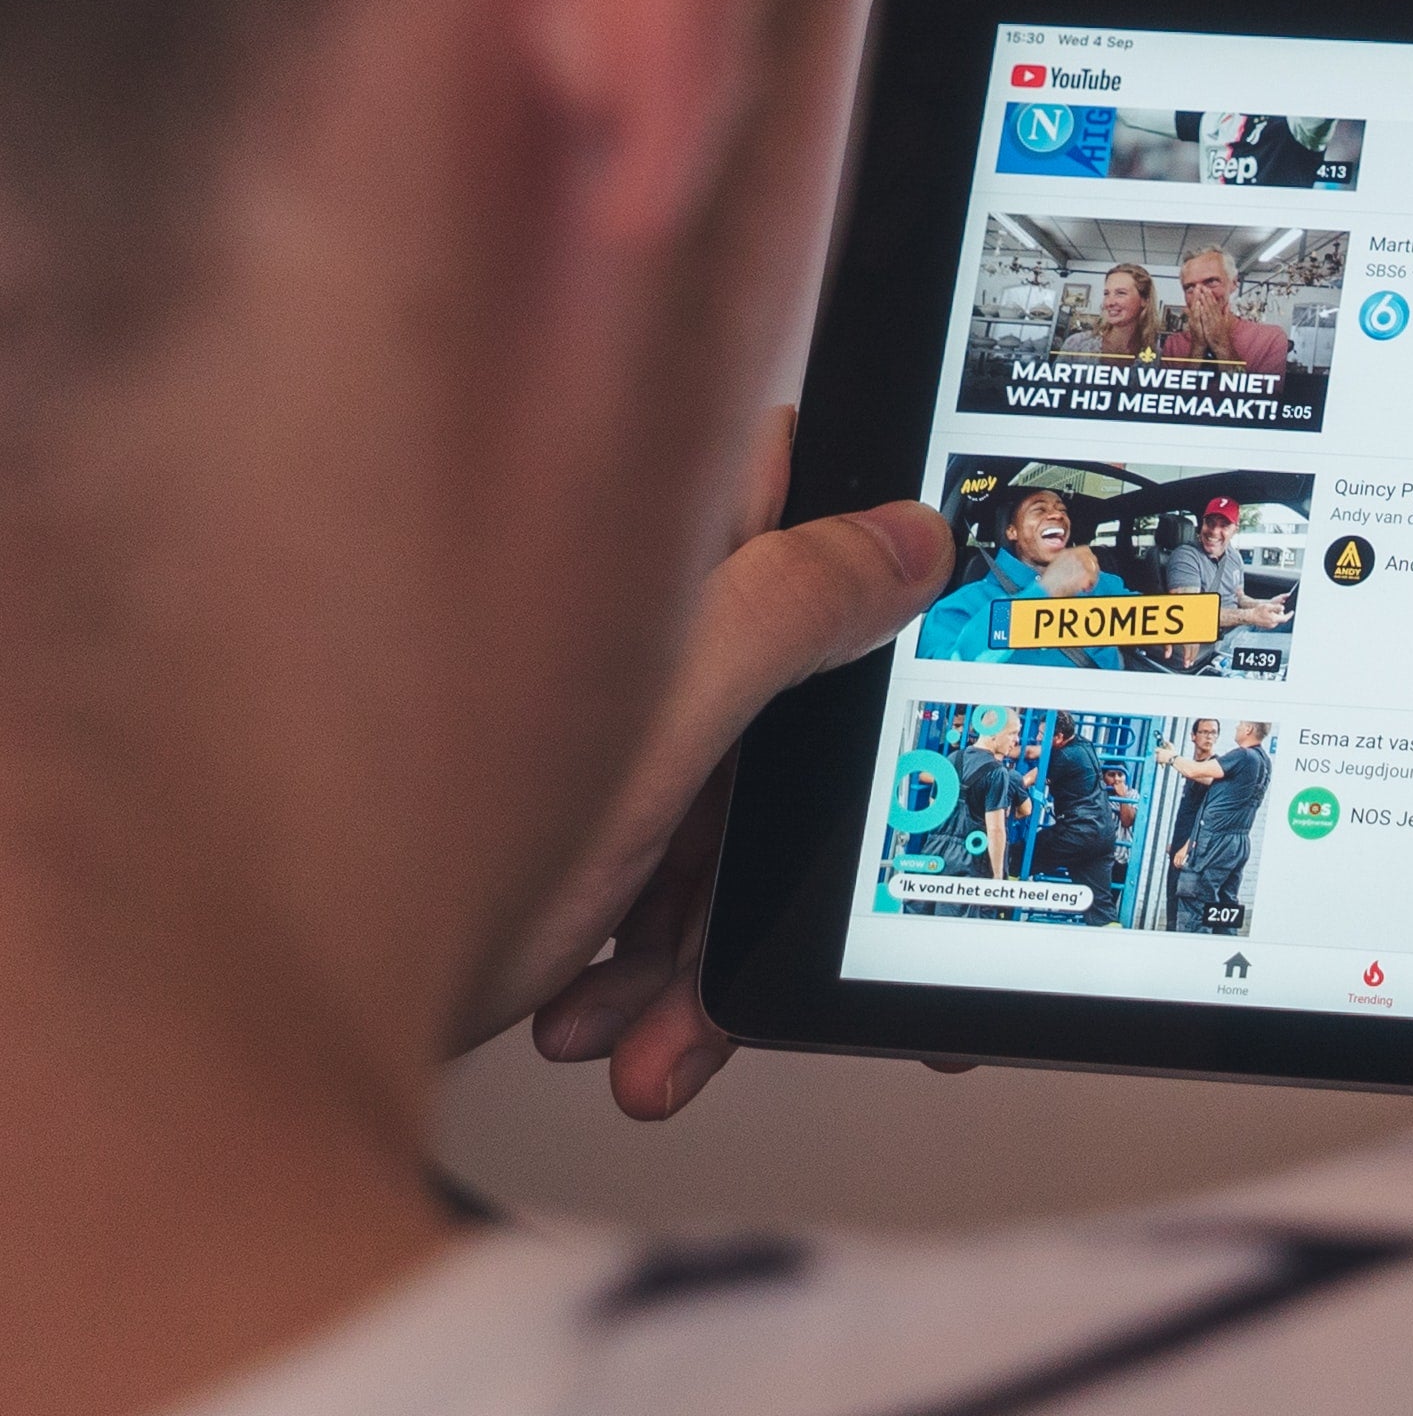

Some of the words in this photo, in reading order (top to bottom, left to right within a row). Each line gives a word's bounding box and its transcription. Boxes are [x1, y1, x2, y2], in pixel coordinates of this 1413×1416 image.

[1007, 32, 1044, 44] 15:30
[1059, 35, 1089, 46] Wed
[1093, 36, 1101, 46] 4
[1107, 37, 1133, 50] Sep
[1052, 67, 1121, 91] YouTube
[1027, 109, 1064, 141] N
[1317, 165, 1346, 178] 4:13
[1366, 264, 1406, 278] SBS6
[1370, 294, 1394, 328] 6
[1011, 361, 1130, 386] MARTIEN
[1138, 368, 1214, 390] WEET
[1219, 372, 1281, 394] NIET
[1006, 386, 1066, 408] WAT
[1071, 390, 1112, 411] HIJ
[1118, 394, 1278, 421] MEEMAAKT!
[1282, 405, 1312, 419] 5:05
[960, 475, 998, 494] ANDY
[1335, 479, 1396, 501] Quincy
[1330, 507, 1370, 525] Andy
[1376, 513, 1402, 524] van
[1334, 567, 1361, 576] ANDY
[1034, 604, 1184, 638] PROMES
[994, 631, 1007, 640] NL
[1239, 653, 1275, 666] 14:39
[1299, 729, 1349, 747] Esma
[1356, 735, 1382, 749] zat
[1295, 758, 1330, 773] NOS
[1351, 808, 1391, 825] NOS
[919, 880, 954, 894] vond
[957, 884, 980, 897] het
[984, 886, 1015, 900] echt
[1018, 889, 1048, 902] heel
[1208, 908, 1239, 922] 2:07
[1217, 985, 1248, 996] Home
[1349, 993, 1393, 1008] Trending
